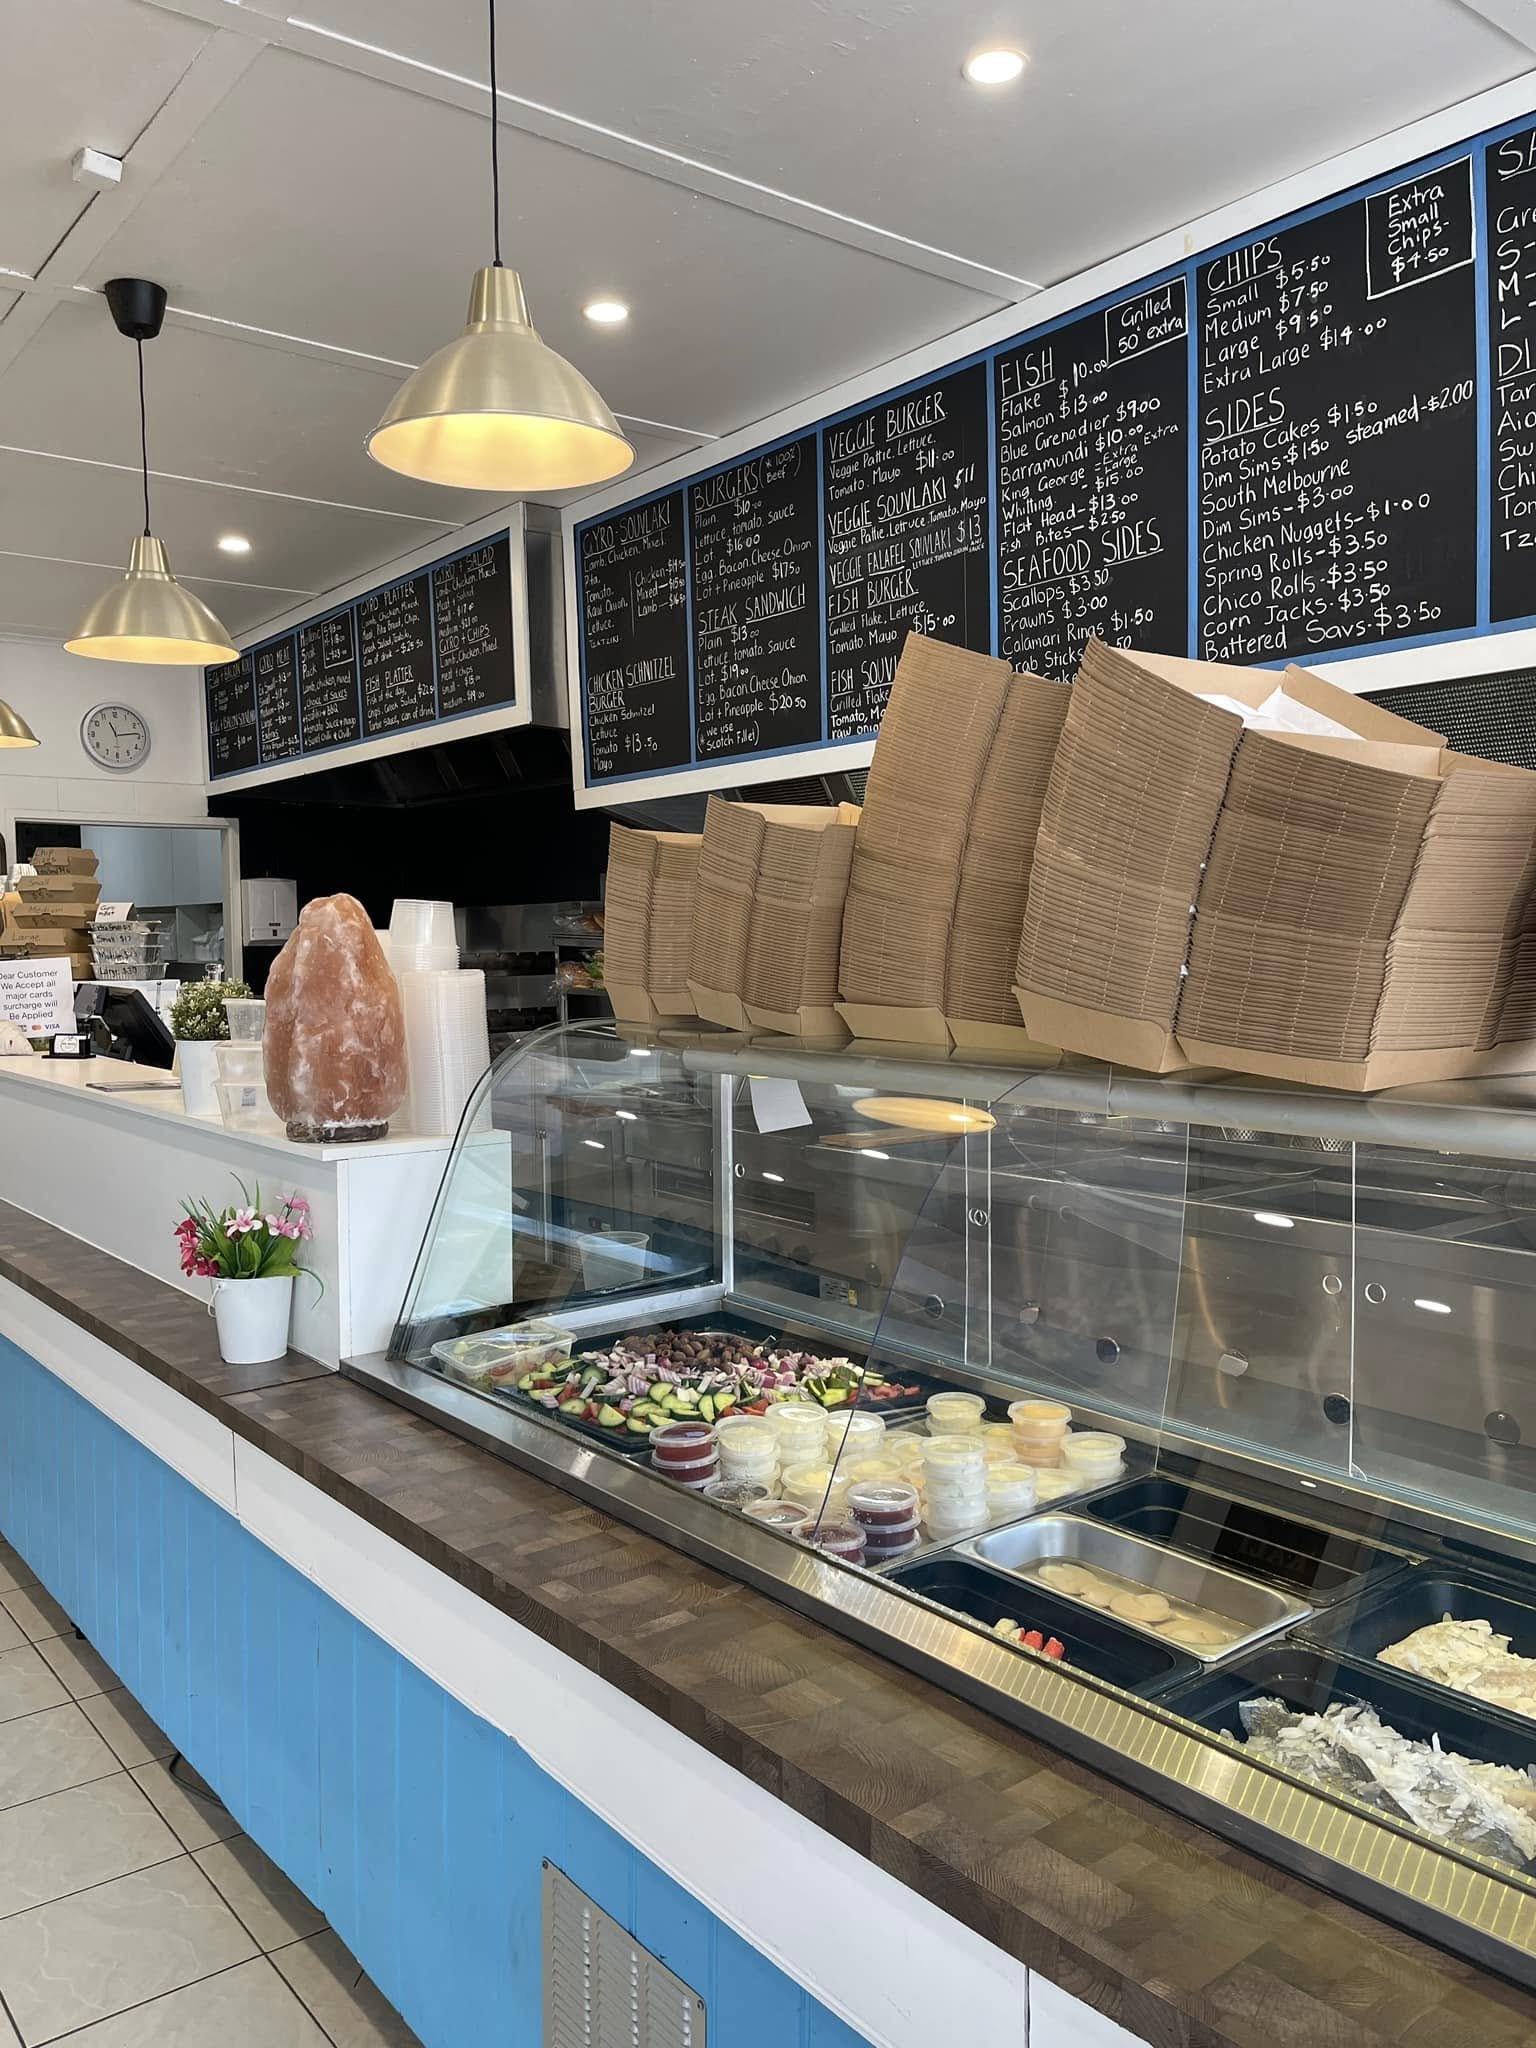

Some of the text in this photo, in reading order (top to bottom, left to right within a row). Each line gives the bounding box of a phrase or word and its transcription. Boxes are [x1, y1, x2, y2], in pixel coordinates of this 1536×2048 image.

[1388, 184, 1444, 218] Extra
[1388, 202, 1439, 237] Small
[1207, 237, 1283, 292] CHIPS
[1391, 247, 1449, 282] $4.50
[1206, 255, 1331, 317] Small $5.50
[1121, 287, 1172, 327] Grilled
[1205, 281, 1328, 342] Medium $7.50
[1147, 316, 1183, 339] extra
[1205, 304, 1332, 368] Large $9.50
[1000, 347, 1055, 398] FISH
[1204, 317, 1387, 394] Extra Large $14.00
[1001, 392, 1041, 420] Flake
[1001, 391, 1108, 441] Salmon $13.00
[1205, 387, 1286, 443] SIDES
[829, 416, 875, 460] VEGGIE
[1000, 398, 1161, 464] Blue Grenadier $9.00
[1201, 402, 1378, 469] Potato Cakes $1.50
[829, 461, 859, 480] Veggie
[1000, 424, 1143, 485] Barramundi $10.00
[694, 463, 758, 511] BURGERS
[1001, 467, 1085, 503] King George
[1202, 458, 1351, 515] South Melbourne
[1203, 471, 1233, 490] Dim
[768, 504, 795, 525] sauce
[828, 500, 872, 535] VEGGIE
[877, 476, 947, 520] SOUVLAKI
[828, 537, 857, 555] Veggie
[1004, 520, 1032, 538] Flat
[1203, 518, 1232, 540] Dim
[830, 556, 862, 586] VEGGIE
[868, 543, 905, 573] FALAFEL
[1000, 538, 1021, 557] Fish
[1003, 539, 1091, 589] SEAFOOD
[1102, 517, 1161, 563] SIDES
[1203, 534, 1274, 564] Chicken
[384, 581, 414, 606] PLATTER
[723, 571, 765, 593] Pineapple
[1204, 564, 1263, 591] Spring
[698, 583, 805, 634] STEAK SANDWICH
[828, 587, 859, 617] FISH
[1003, 586, 1065, 613] Scallops
[1004, 595, 1108, 633] Prawns $3.00
[1203, 590, 1262, 616] Chico
[698, 635, 722, 651] Plain
[829, 617, 855, 637] Grilled
[1003, 634, 1061, 655] Calamari
[1110, 609, 1154, 632] $1.50
[1203, 615, 1251, 638] Corn
[1205, 624, 1287, 662] Battered
[768, 637, 796, 654] sauce
[587, 655, 676, 695] CHICKEN SCHNITZEL
[831, 667, 854, 694] FISH
[589, 690, 625, 712] BURGER
[830, 696, 862, 713] Grilled
[17, 971, 58, 979] Customer
[3, 1001, 42, 1010] surcharge
[22, 1011, 53, 1019] Applied
